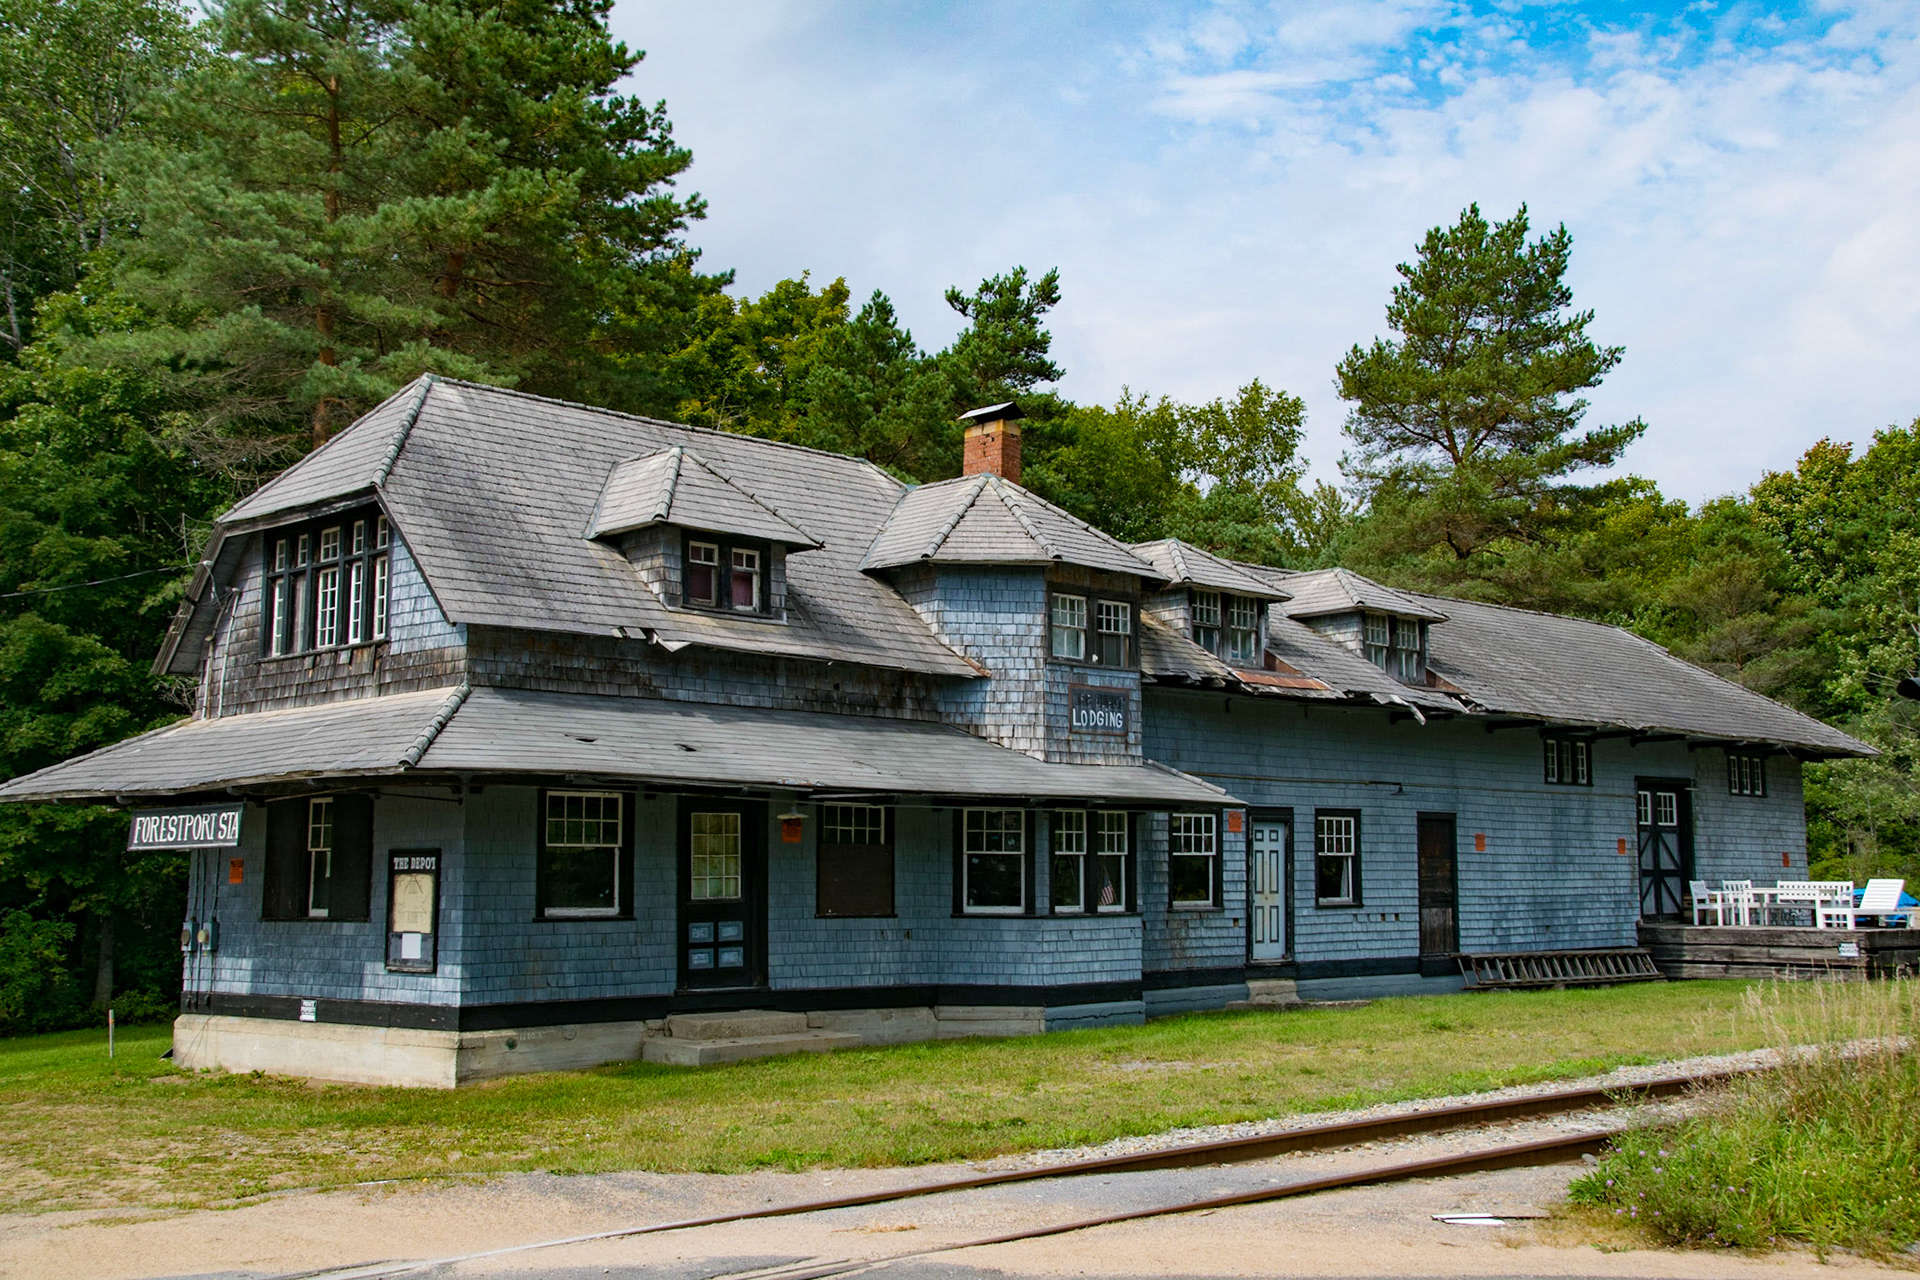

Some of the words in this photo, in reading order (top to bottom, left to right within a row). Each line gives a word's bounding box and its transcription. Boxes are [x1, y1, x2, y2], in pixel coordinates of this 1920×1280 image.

[133, 812, 217, 843] FORESTPORT
[218, 811, 239, 839] STA
[393, 857, 409, 870] THE
[410, 857, 436, 870] DEPOT
